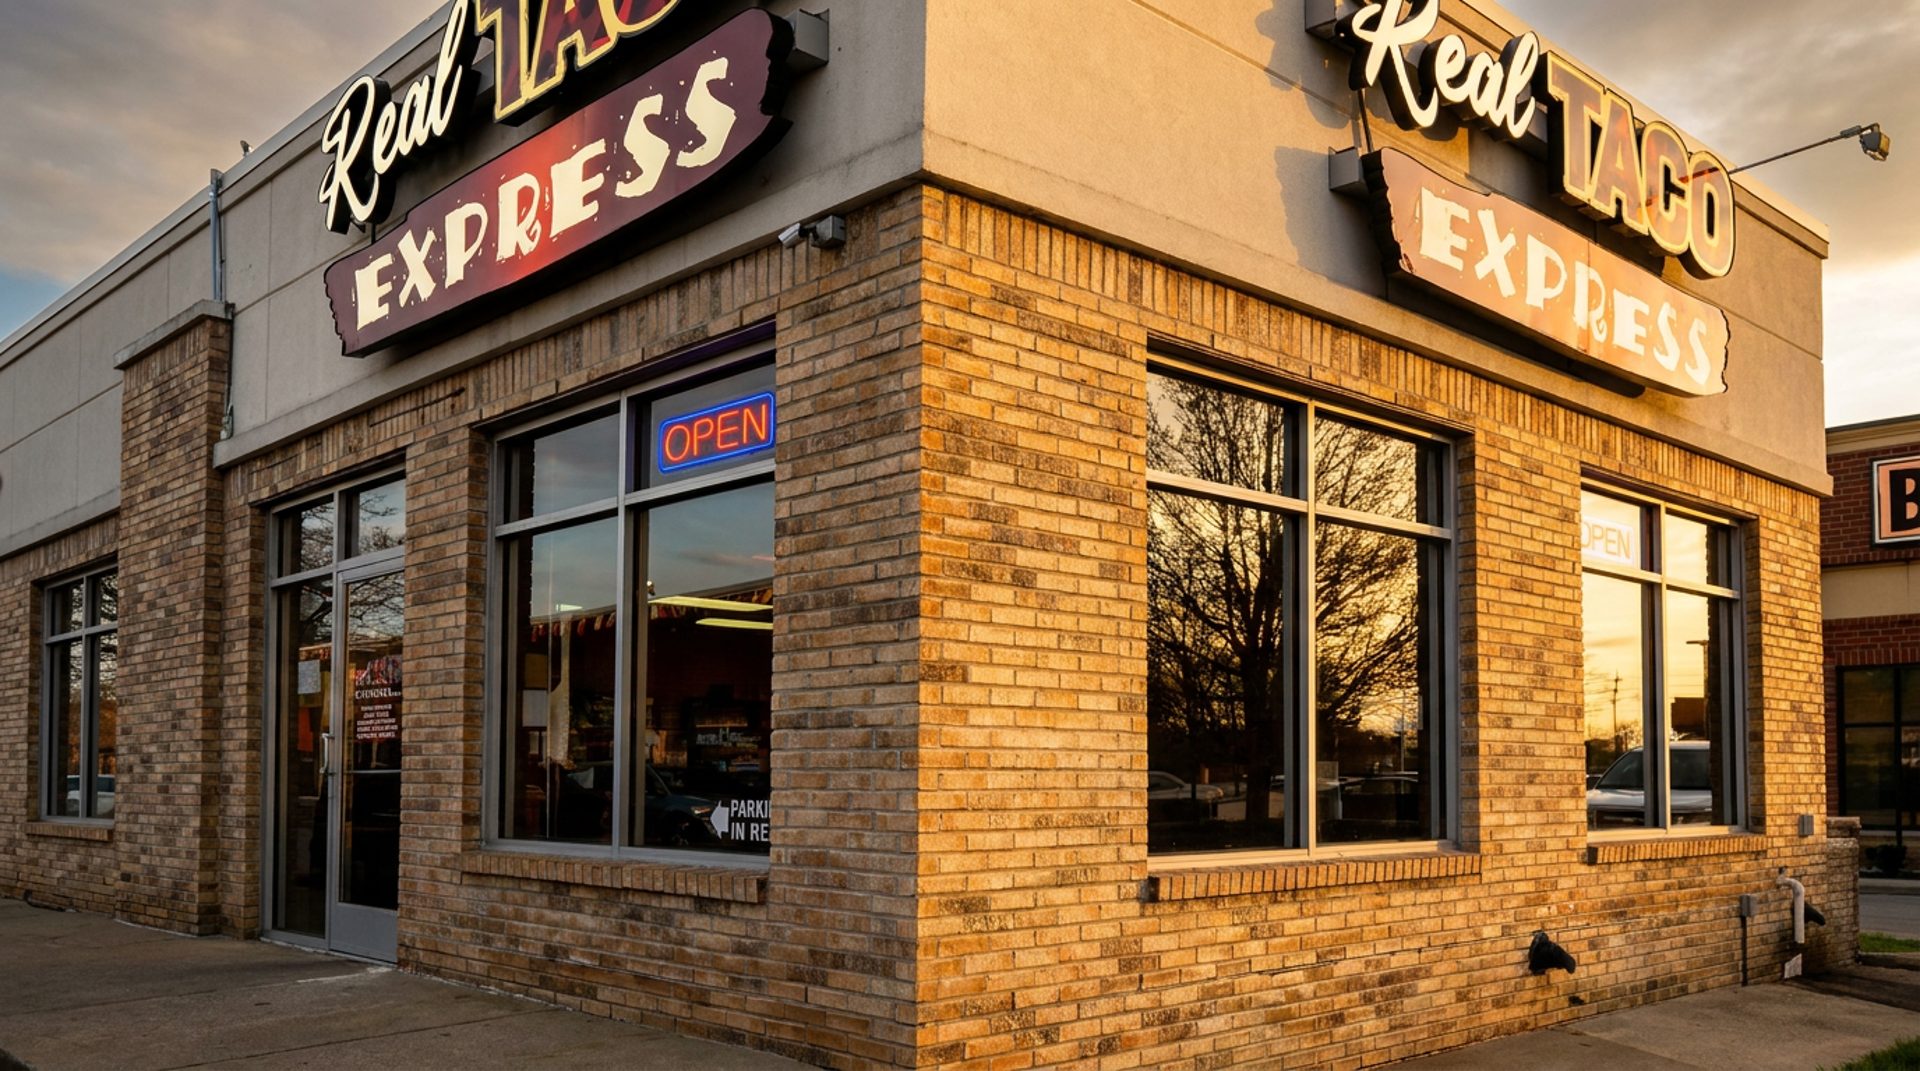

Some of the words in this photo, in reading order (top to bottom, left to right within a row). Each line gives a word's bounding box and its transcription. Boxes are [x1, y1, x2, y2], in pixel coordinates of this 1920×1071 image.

[319, 0, 468, 231] Real
[476, 0, 681, 120] TA
[1352, 0, 1539, 139] Real
[1547, 52, 1735, 278] TACO
[356, 56, 737, 331] EXPRESS
[1419, 186, 1712, 386] EXPRESS
[664, 403, 767, 463] OPEN
[1581, 521, 1631, 560] OPEN
[730, 799, 770, 819] PARKI
[730, 822, 745, 841] IN
[750, 822, 769, 842] RE
